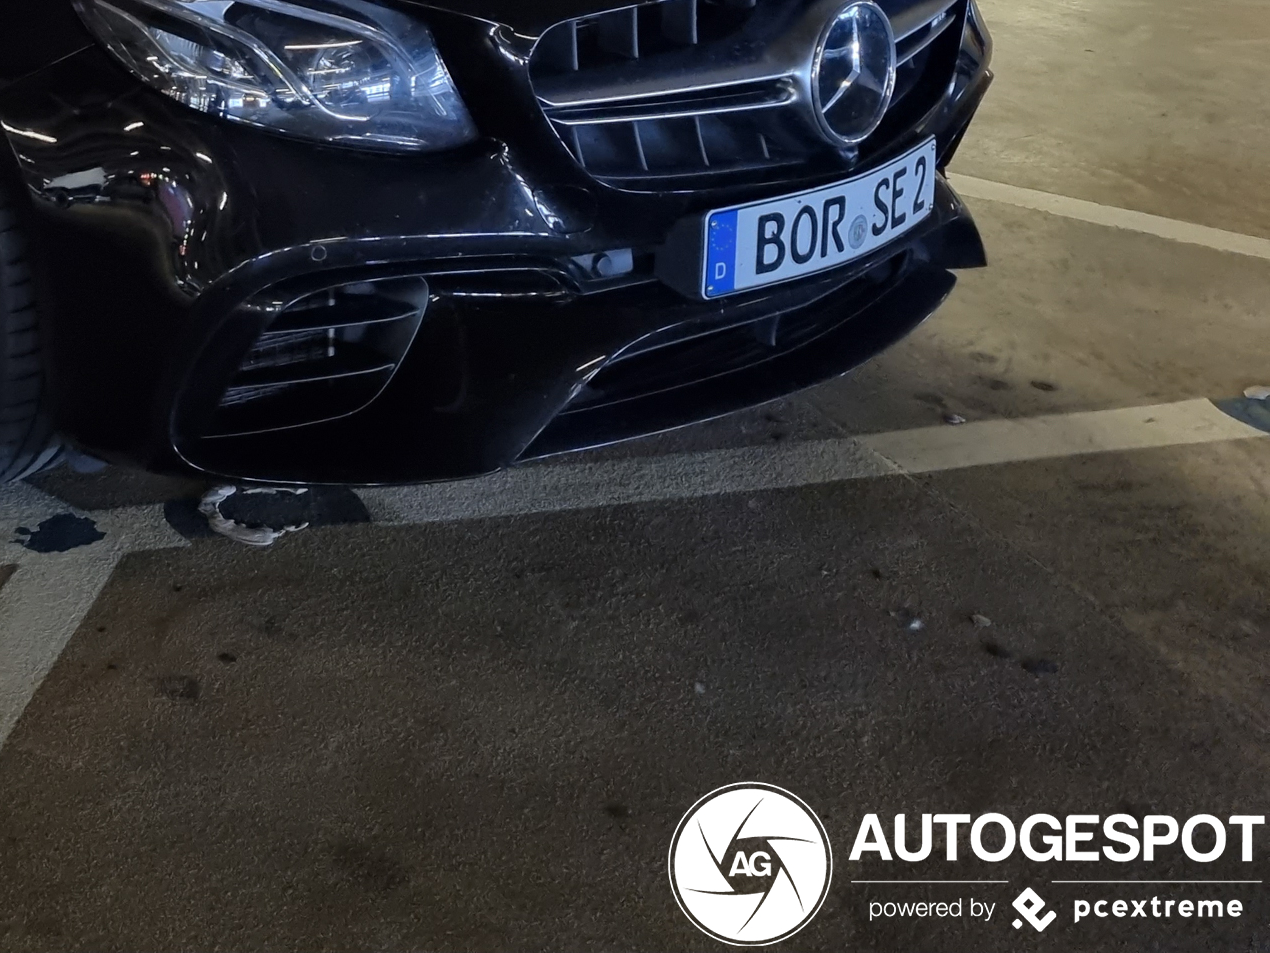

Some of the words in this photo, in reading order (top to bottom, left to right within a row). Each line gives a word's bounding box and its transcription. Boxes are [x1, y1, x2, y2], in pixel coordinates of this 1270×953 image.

[714, 261, 726, 280] D
[755, 194, 846, 275] BOR
[871, 165, 907, 237] SE
[912, 155, 927, 216] 2
